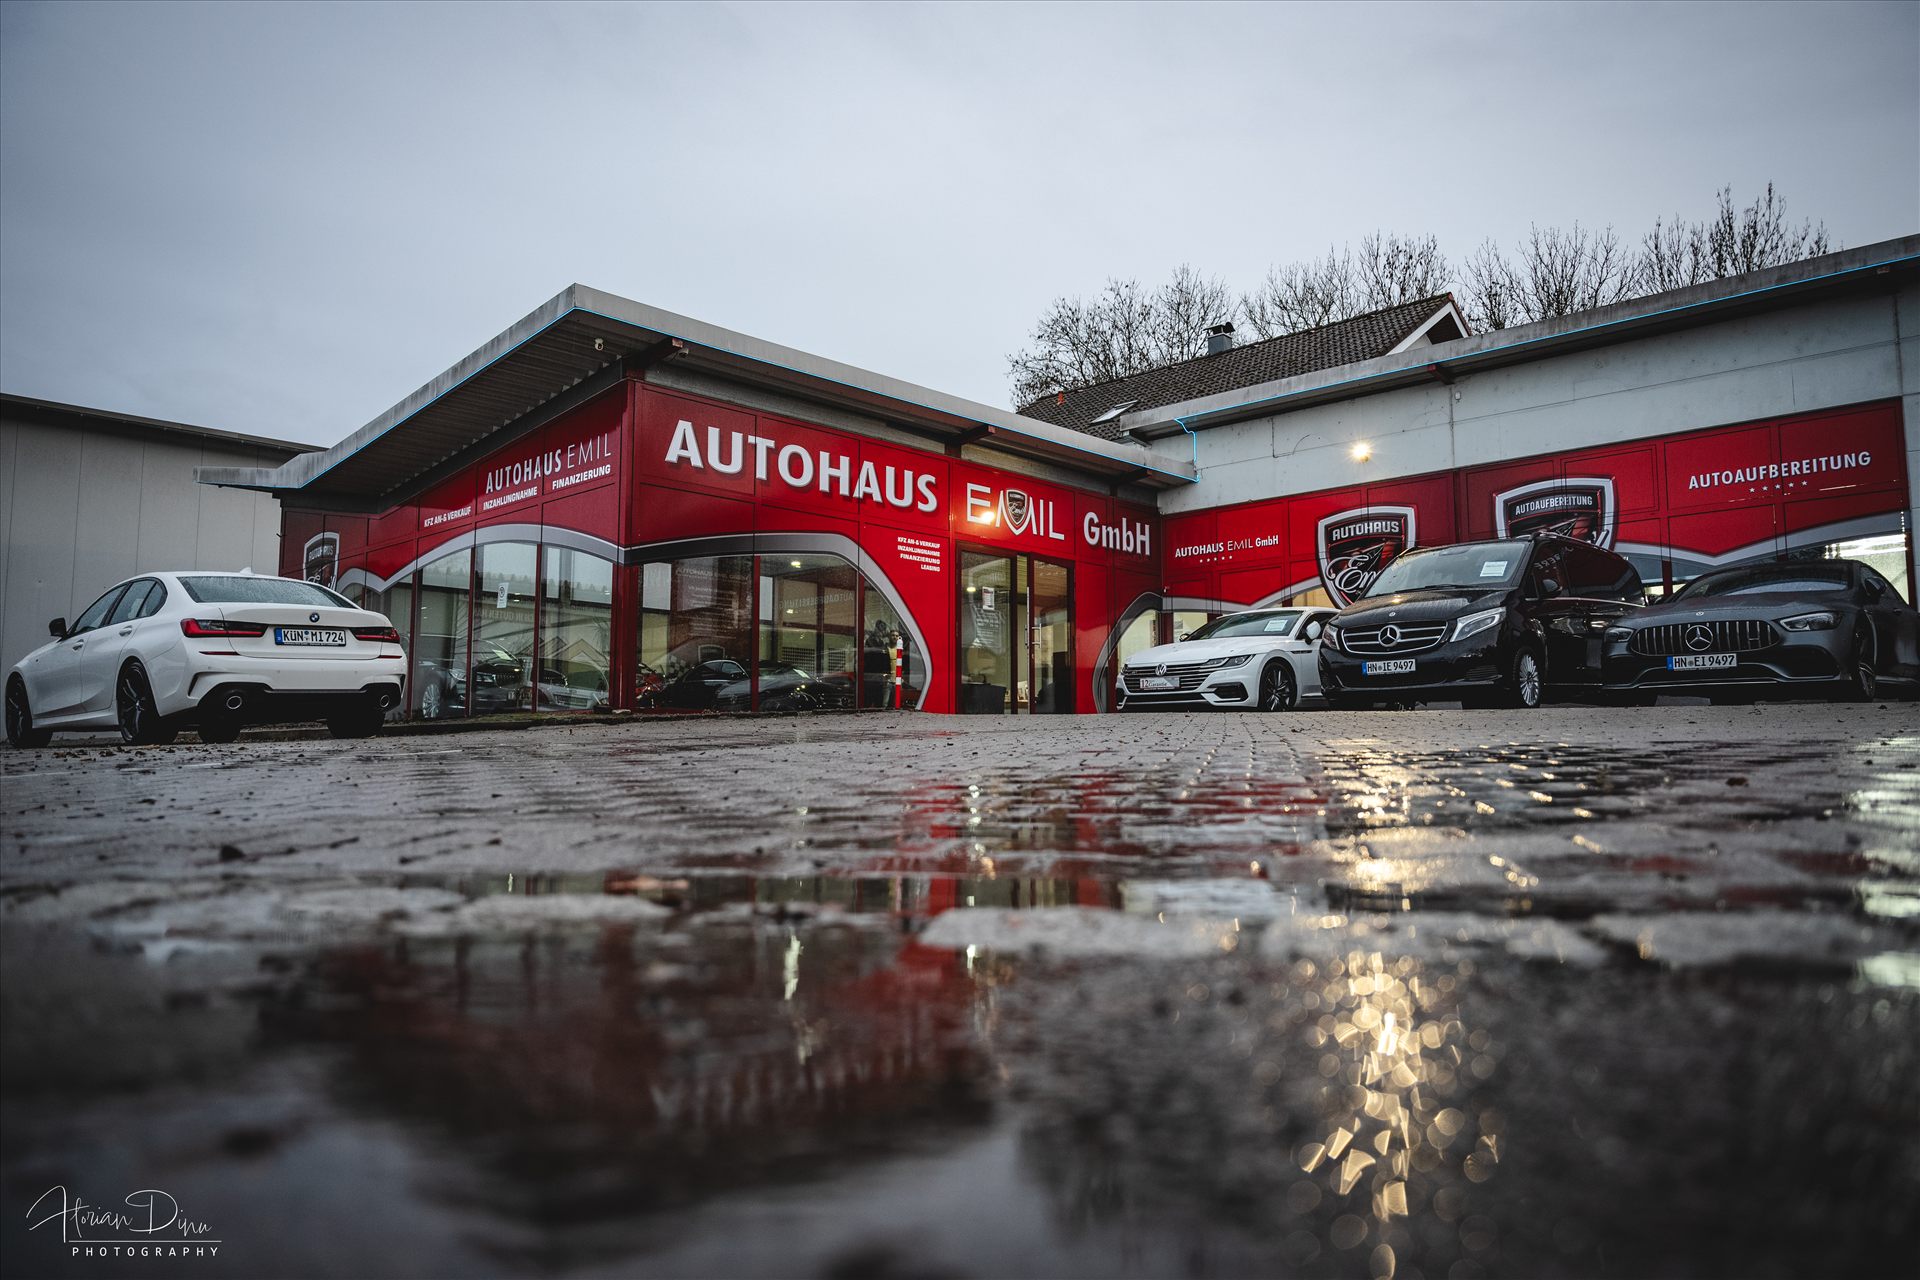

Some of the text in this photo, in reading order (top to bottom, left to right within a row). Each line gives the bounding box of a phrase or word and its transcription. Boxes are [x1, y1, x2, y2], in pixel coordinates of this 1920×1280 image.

[485, 433, 612, 494] AUTOHAUS EMIL
[1688, 451, 1872, 490] AUTOAUFBEREITUNG
[552, 464, 611, 491] FINANZIERUNG
[664, 419, 1151, 556] AUTOHAUS EMIL GmbH
[483, 486, 538, 511] INZAHLUNGNAHME
[1515, 496, 1593, 516] AUTOAUFBEREITUNG
[424, 517, 434, 528] KFZ
[447, 506, 472, 521] VERKAUF
[1332, 521, 1400, 541] AUTOHAUS
[1175, 534, 1279, 558] AUTOHAUS EMIL GmbH
[283, 630, 344, 643] KÜN MI 724
[1367, 660, 1414, 673] HN IE 9497
[1674, 654, 1735, 668] HN EI 9497
[1142, 679, 1149, 688] 12
